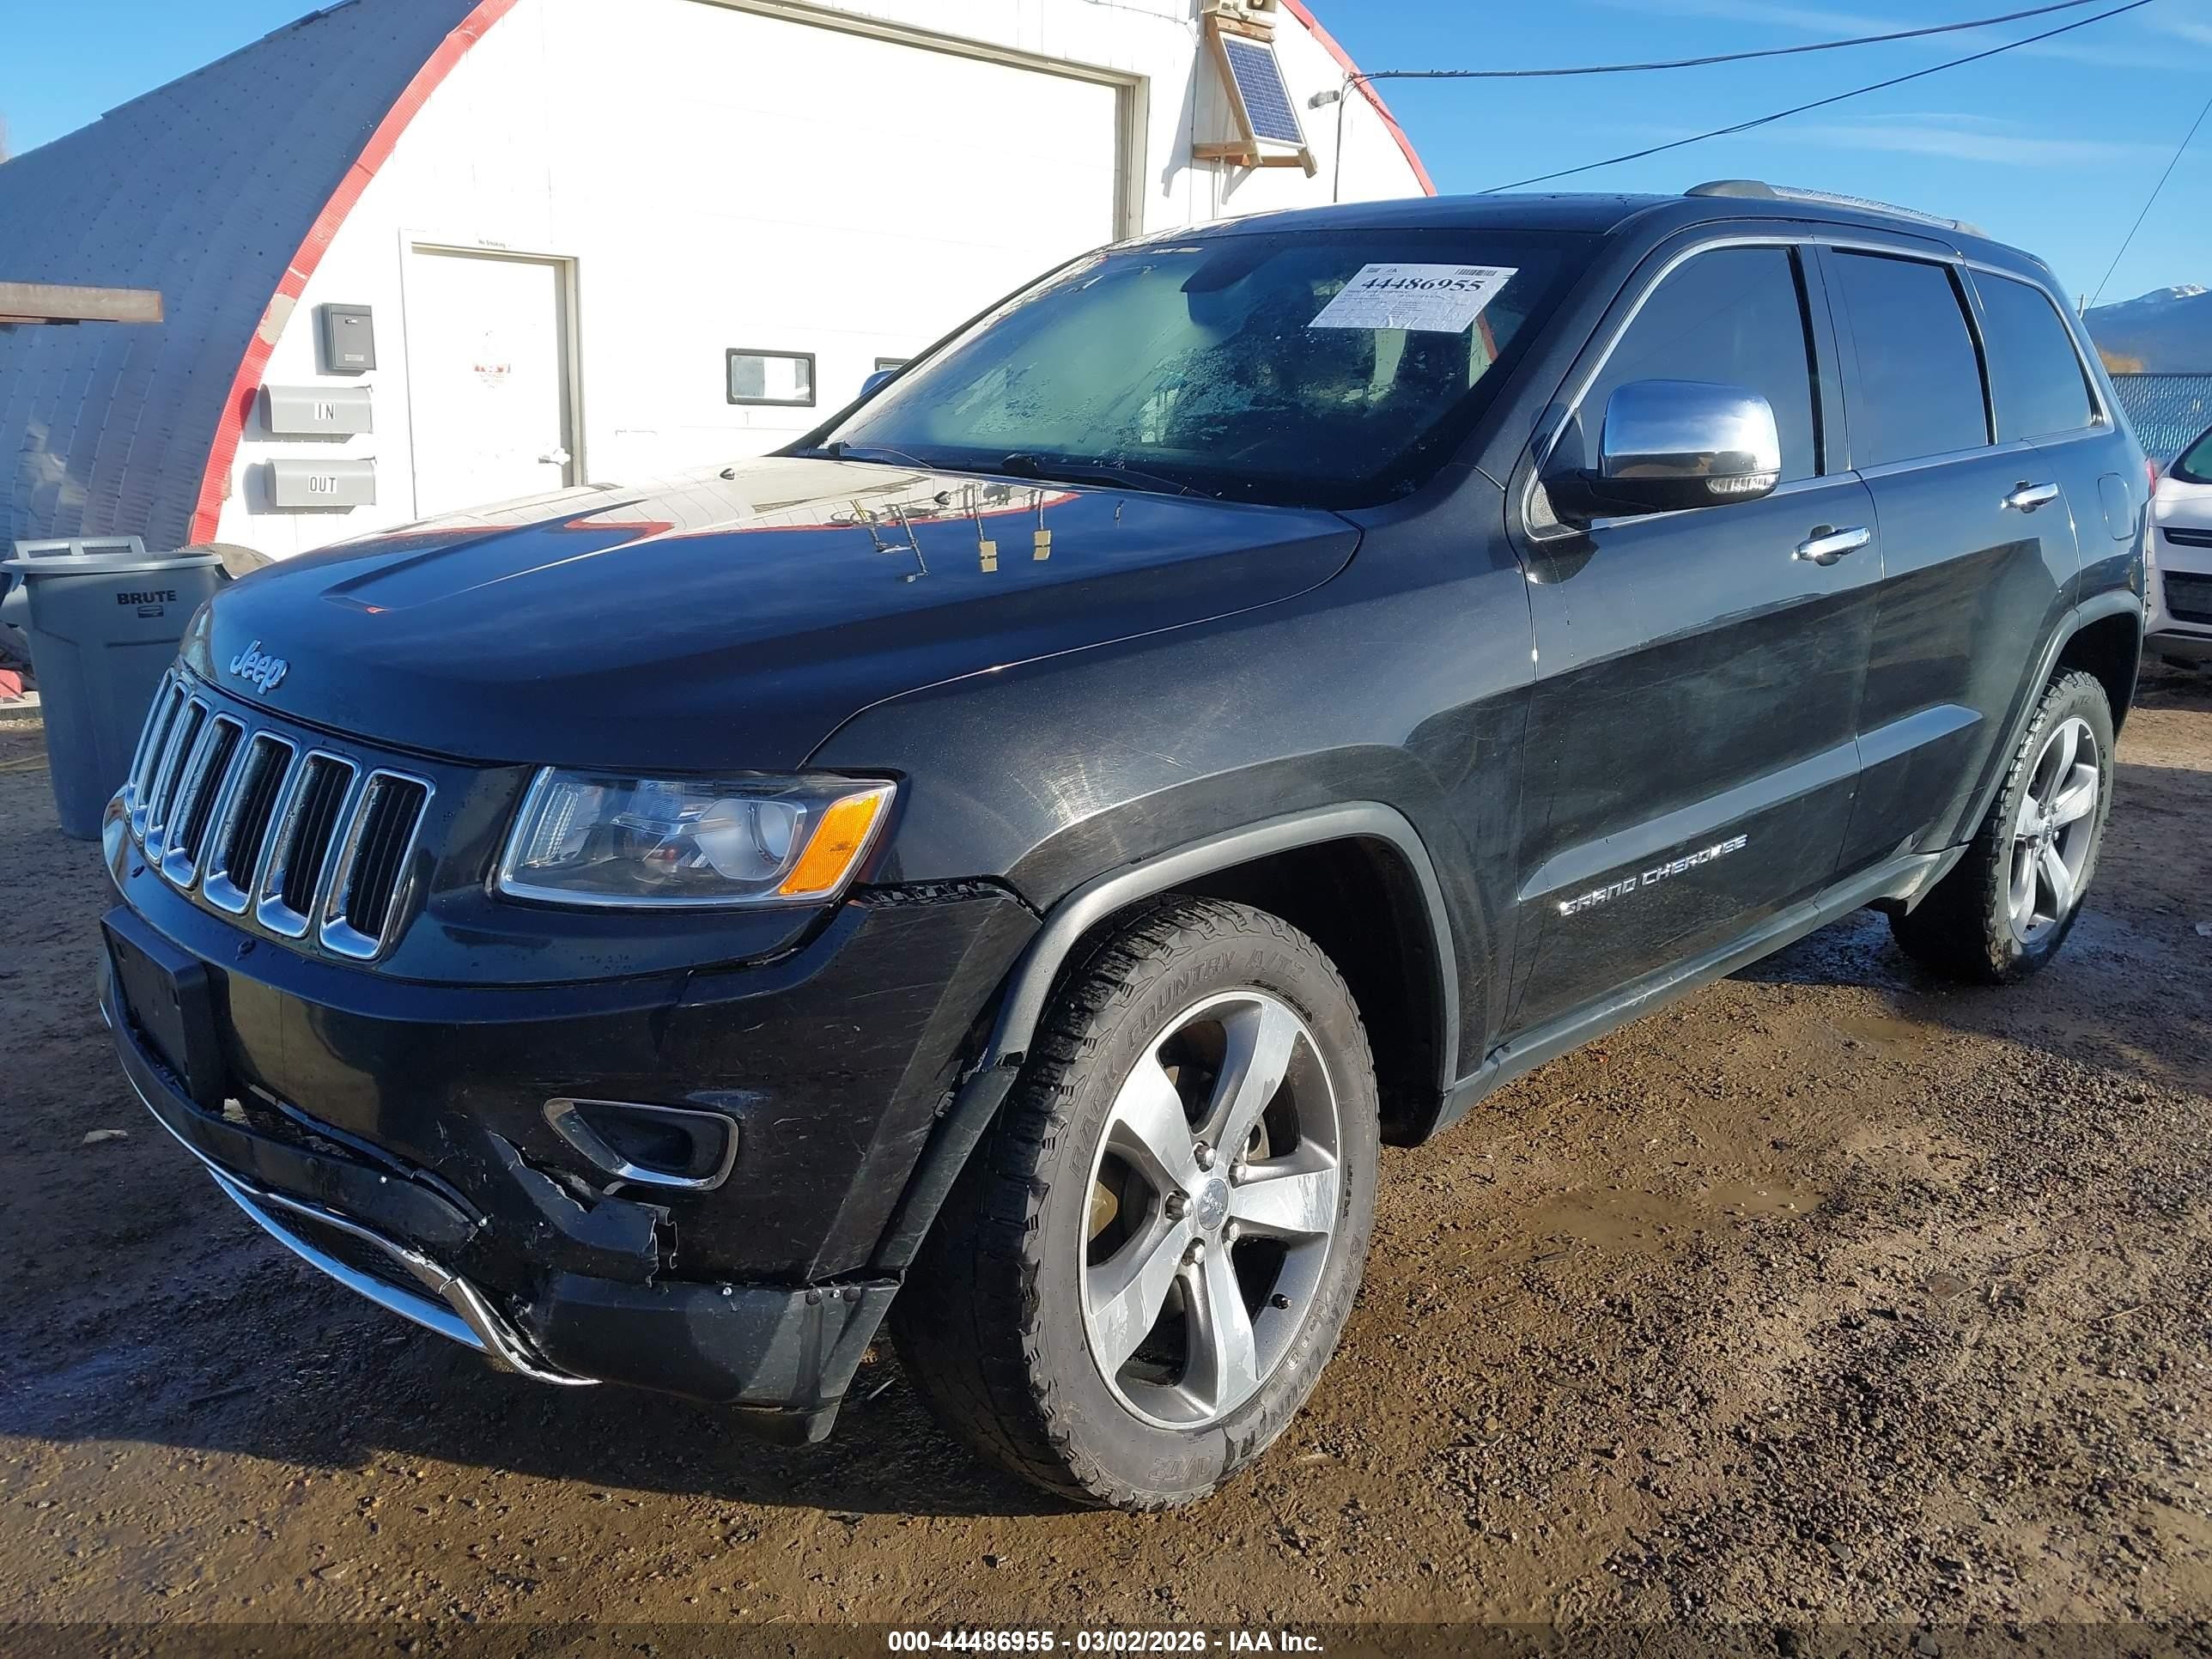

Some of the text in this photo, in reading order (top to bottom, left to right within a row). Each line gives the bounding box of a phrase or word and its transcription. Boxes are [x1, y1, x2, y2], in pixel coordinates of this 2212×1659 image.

[1361, 277, 1486, 292] 44486955
[319, 404, 334, 420] IN
[309, 477, 337, 492] OUT
[117, 590, 177, 605] BRUTE
[229, 640, 288, 696] Jeep
[1559, 834, 1748, 917] GRAND CHEROKEE
[1127, 950, 1237, 1052] COUNTRY
